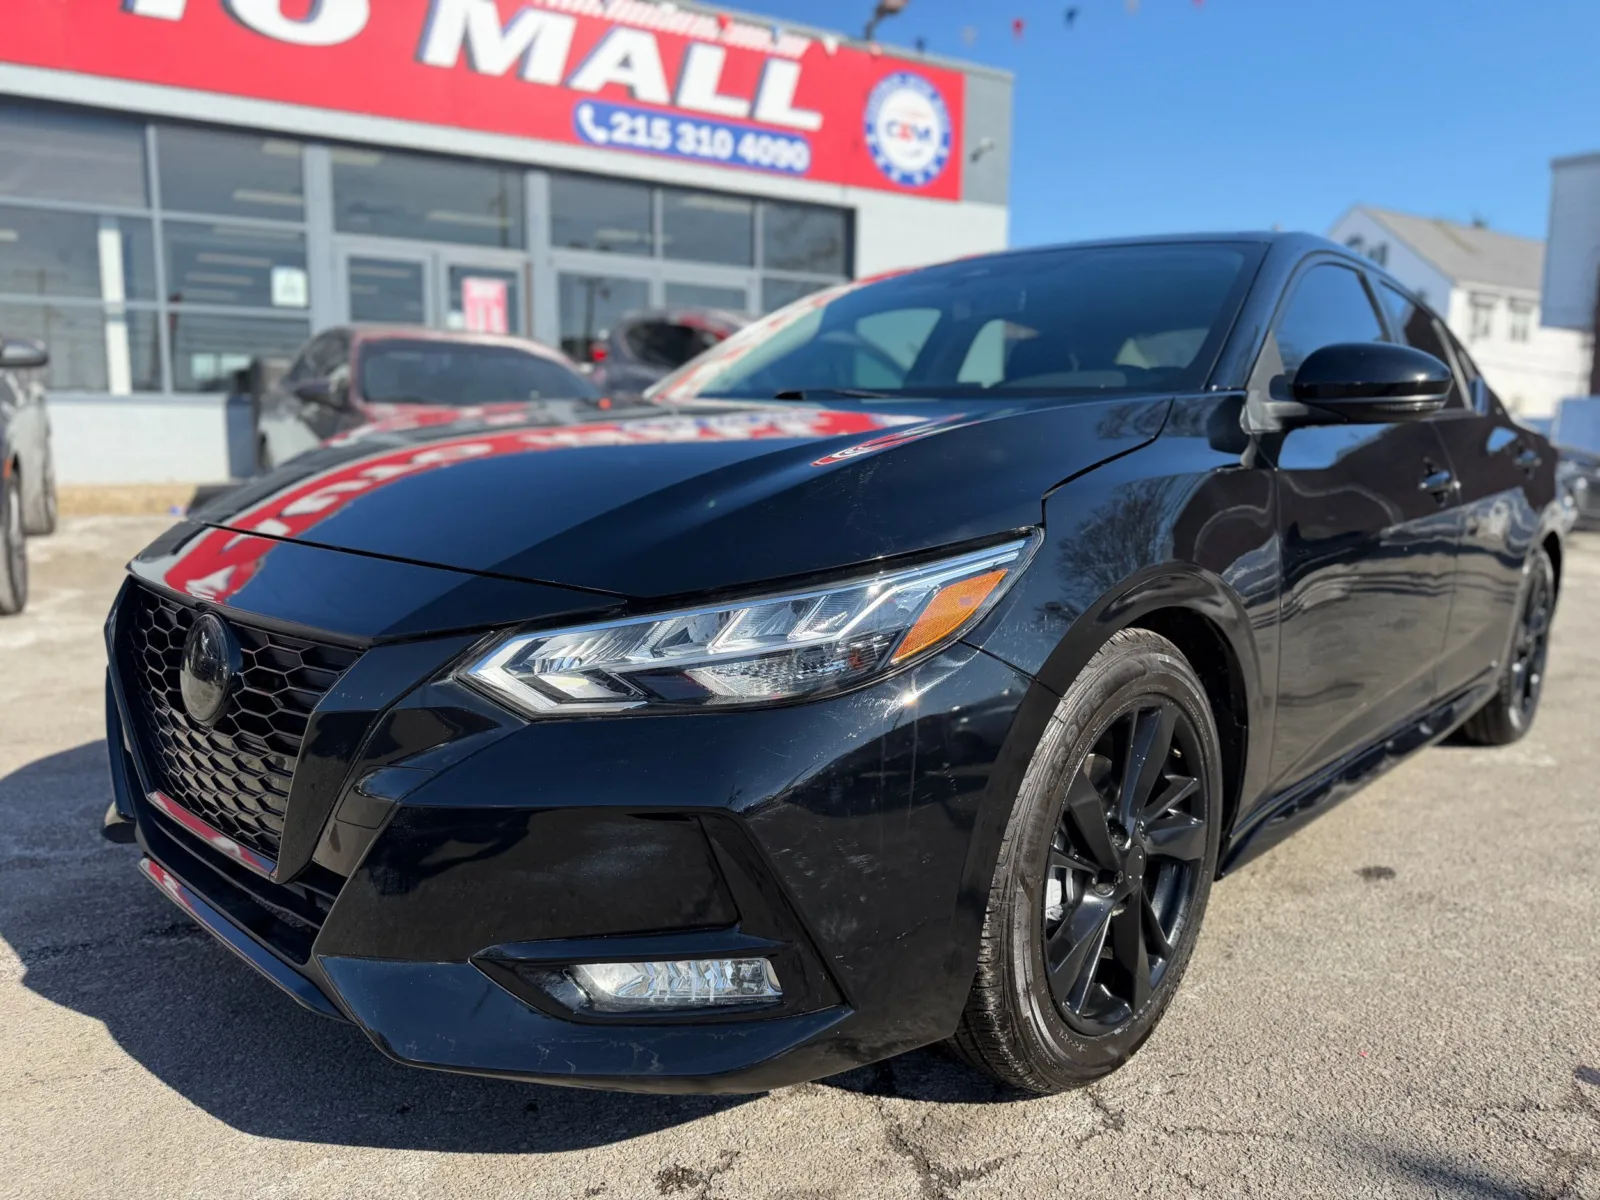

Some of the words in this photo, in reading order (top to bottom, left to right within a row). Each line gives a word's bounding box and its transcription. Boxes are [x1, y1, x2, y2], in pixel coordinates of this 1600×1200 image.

[414, 0, 823, 131] MALL
[610, 111, 671, 150] 215
[676, 122, 735, 160] 310
